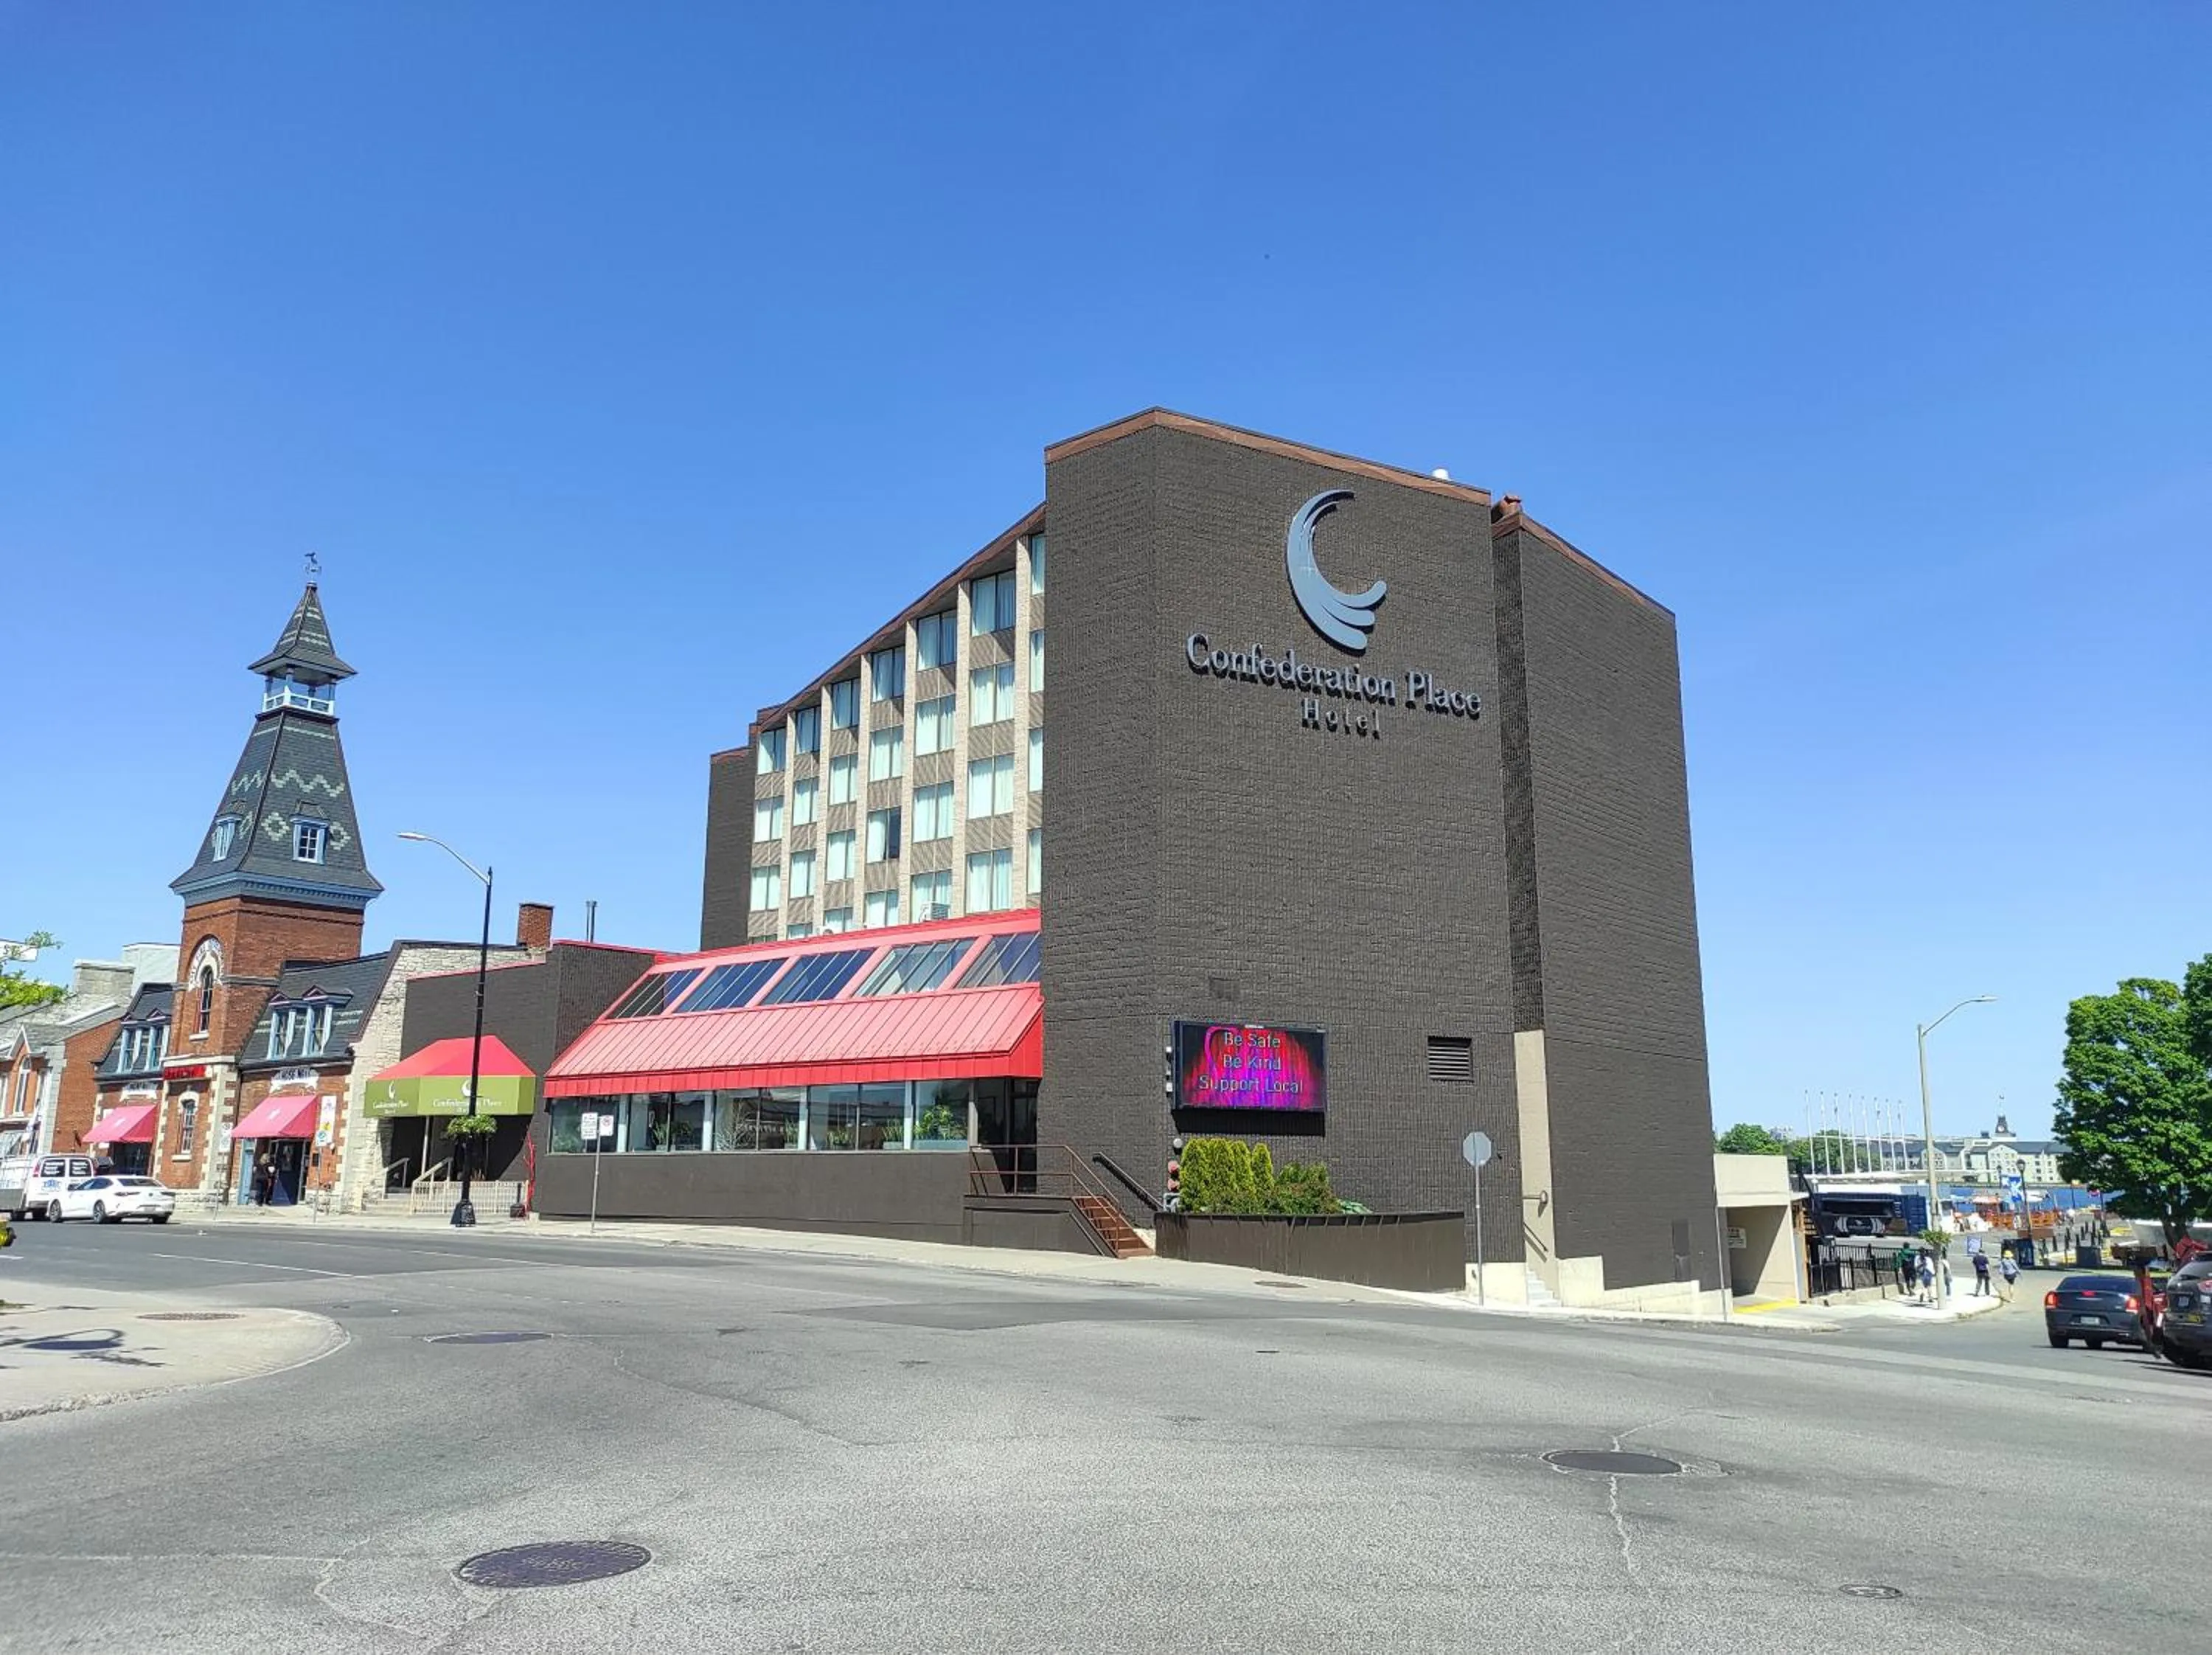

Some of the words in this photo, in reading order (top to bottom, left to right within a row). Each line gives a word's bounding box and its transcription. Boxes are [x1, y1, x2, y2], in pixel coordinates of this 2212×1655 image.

[1186, 633, 1397, 701] Confederation
[1407, 670, 1482, 715] Place
[1302, 697, 1380, 733] Hotel
[1224, 1032, 1243, 1047] Be
[1247, 1033, 1281, 1049] Safe
[1222, 1054, 1242, 1069] Be
[1248, 1056, 1281, 1070] Kind
[1198, 1074, 1260, 1092] Support
[1265, 1077, 1304, 1093] Local
